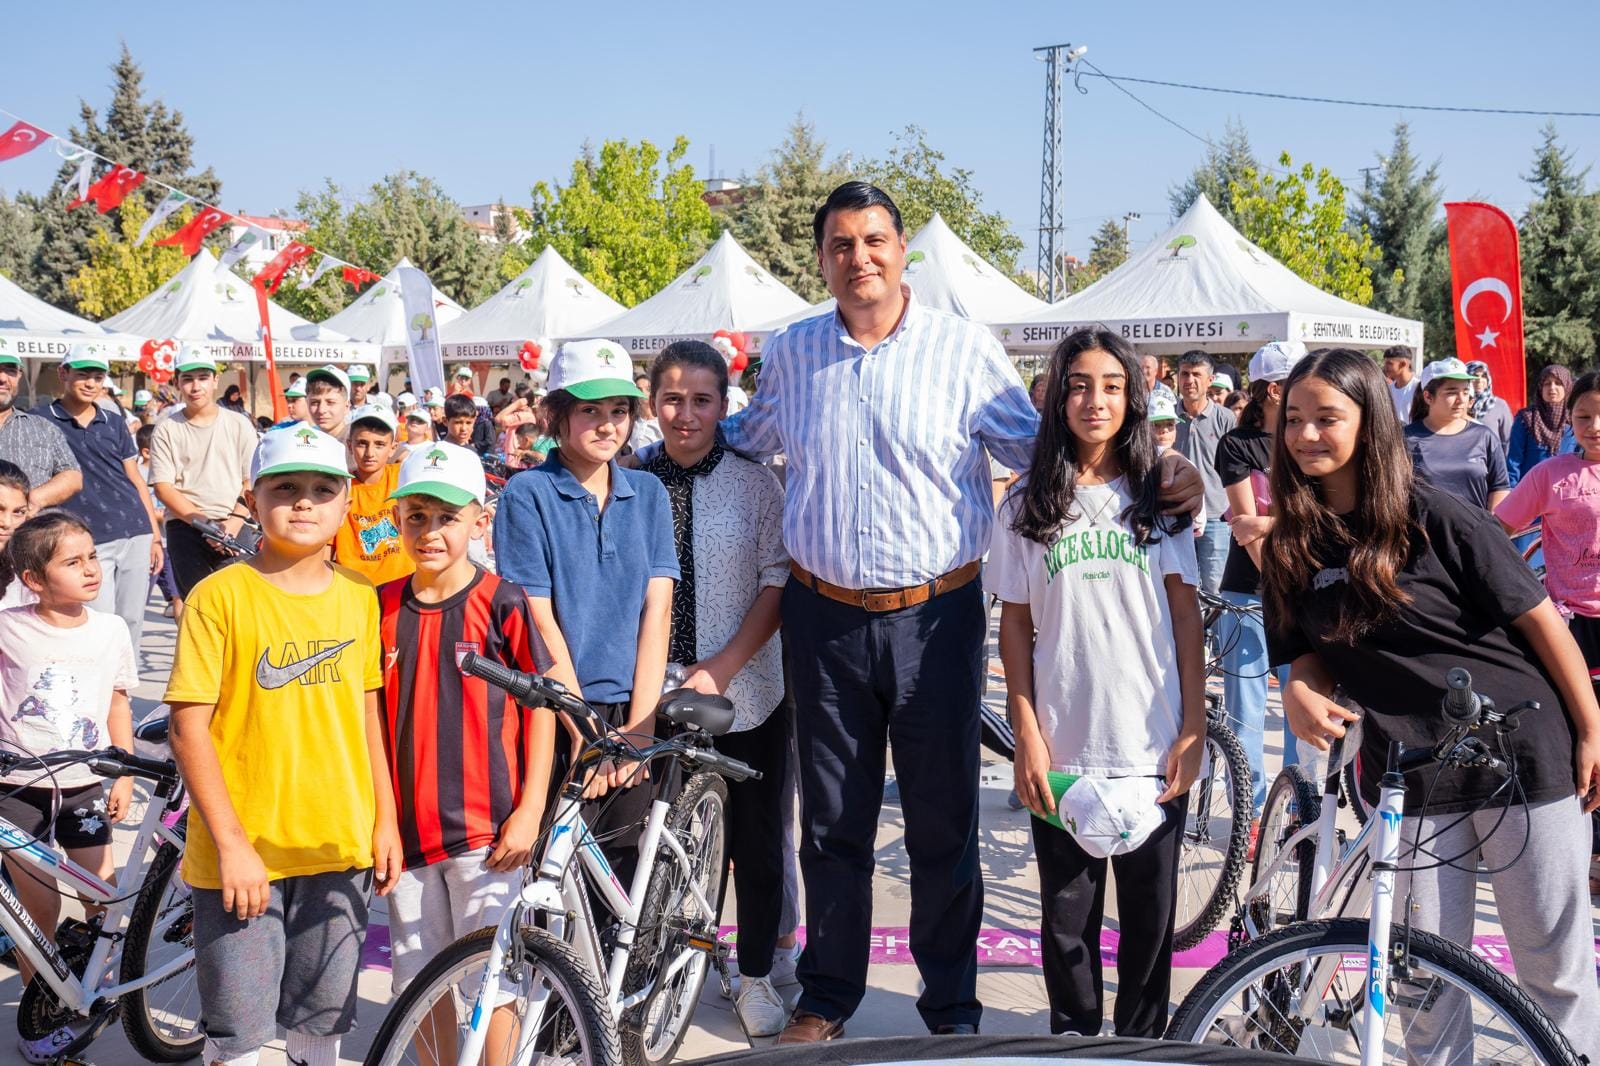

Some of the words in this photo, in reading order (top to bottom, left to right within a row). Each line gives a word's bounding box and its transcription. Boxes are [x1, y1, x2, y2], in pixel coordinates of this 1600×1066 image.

[1023, 326, 1078, 343] ŞEHİTK
[1121, 321, 1224, 339] BELEDİYESİ
[17, 341, 71, 354] BELED
[456, 345, 509, 357] BELEDİYESİ
[631, 338, 696, 350] BELED
[204, 345, 263, 357] HİTKAMİL
[275, 346, 343, 359] BELEDİYESİ
[1081, 531, 1095, 560] &
[279, 639, 343, 686] AIR
